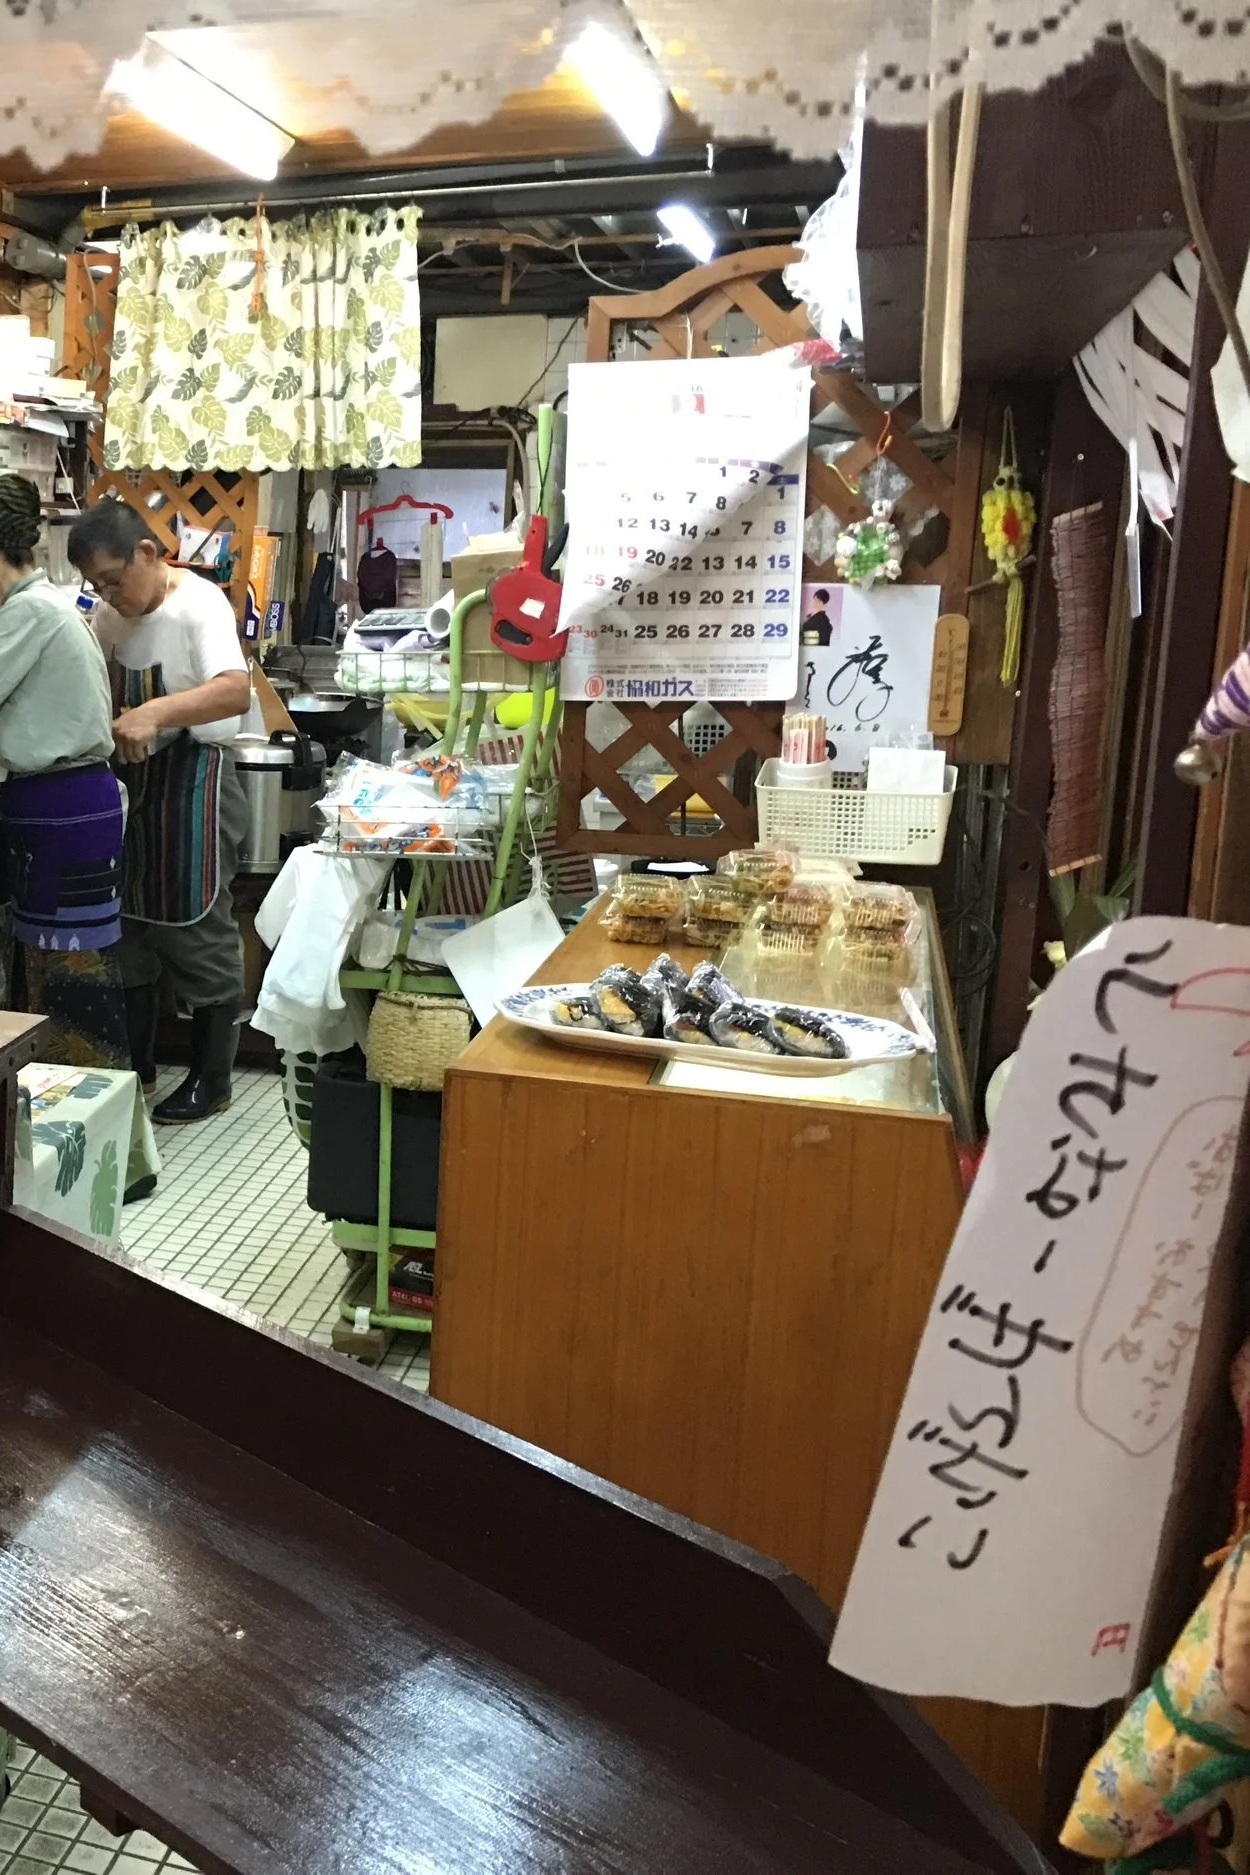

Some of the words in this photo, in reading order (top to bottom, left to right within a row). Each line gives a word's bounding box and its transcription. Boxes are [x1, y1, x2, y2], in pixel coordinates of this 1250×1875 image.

[719, 466, 727, 477] 1
[749, 470, 760, 484] 2
[686, 492, 697, 504] 7
[716, 496, 727, 510] 8
[777, 486, 785, 499] 1
[618, 518, 638, 528] 12
[650, 518, 670, 532] 13
[679, 522, 698, 539] 14
[741, 521, 753, 535] 7
[773, 520, 786, 535] 8
[618, 546, 638, 559] 19
[645, 550, 666, 566] 20
[702, 556, 724, 570] 13
[734, 555, 757, 569] 14
[767, 555, 791, 569] 15
[612, 576, 632, 593] 26
[636, 591, 659, 605] 18
[668, 590, 691, 605] 19
[699, 590, 724, 604] 20
[732, 589, 754, 604] 21
[764, 589, 790, 603] 22
[583, 629, 597, 638] 30
[600, 624, 614, 633] 24
[615, 629, 628, 638] 31
[634, 625, 658, 639] 25
[666, 624, 690, 639] 26
[698, 624, 723, 638] 27
[730, 623, 755, 638] 28
[763, 623, 789, 637] 29
[626, 677, 694, 698] 協和ガス
